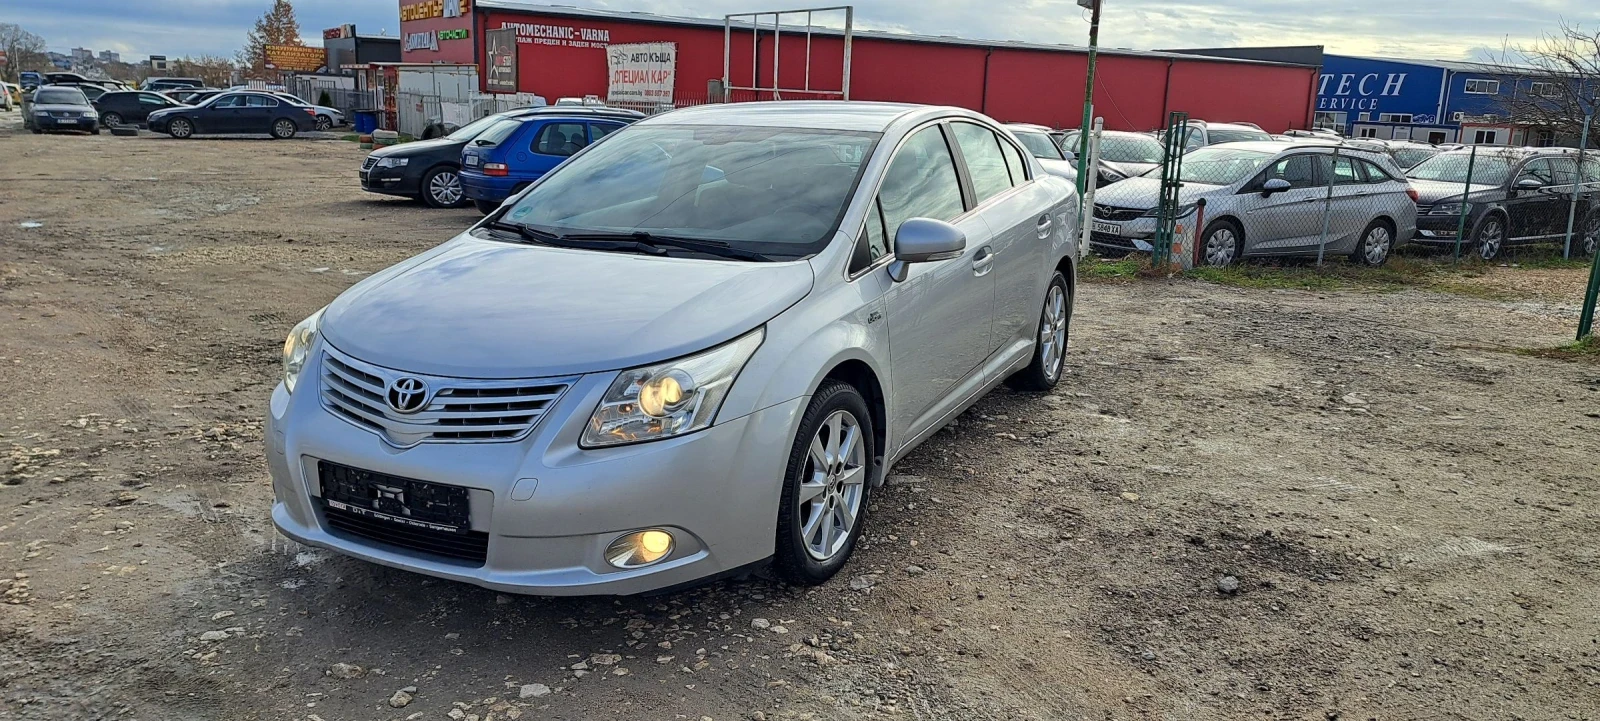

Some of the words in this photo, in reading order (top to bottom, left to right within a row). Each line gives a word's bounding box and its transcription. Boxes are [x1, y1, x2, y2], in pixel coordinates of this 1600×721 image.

[534, 38, 561, 46] ПРЕДЕН
[265, 45, 312, 53] ИЗКУПУВАНЕ
[266, 50, 325, 59] КАТАЛИЗАТОРИ
[630, 52, 648, 63] АВТО
[649, 52, 671, 64] КЪЩА
[1316, 98, 1378, 110] ERVICE
[1111, 225, 1119, 234] XA
